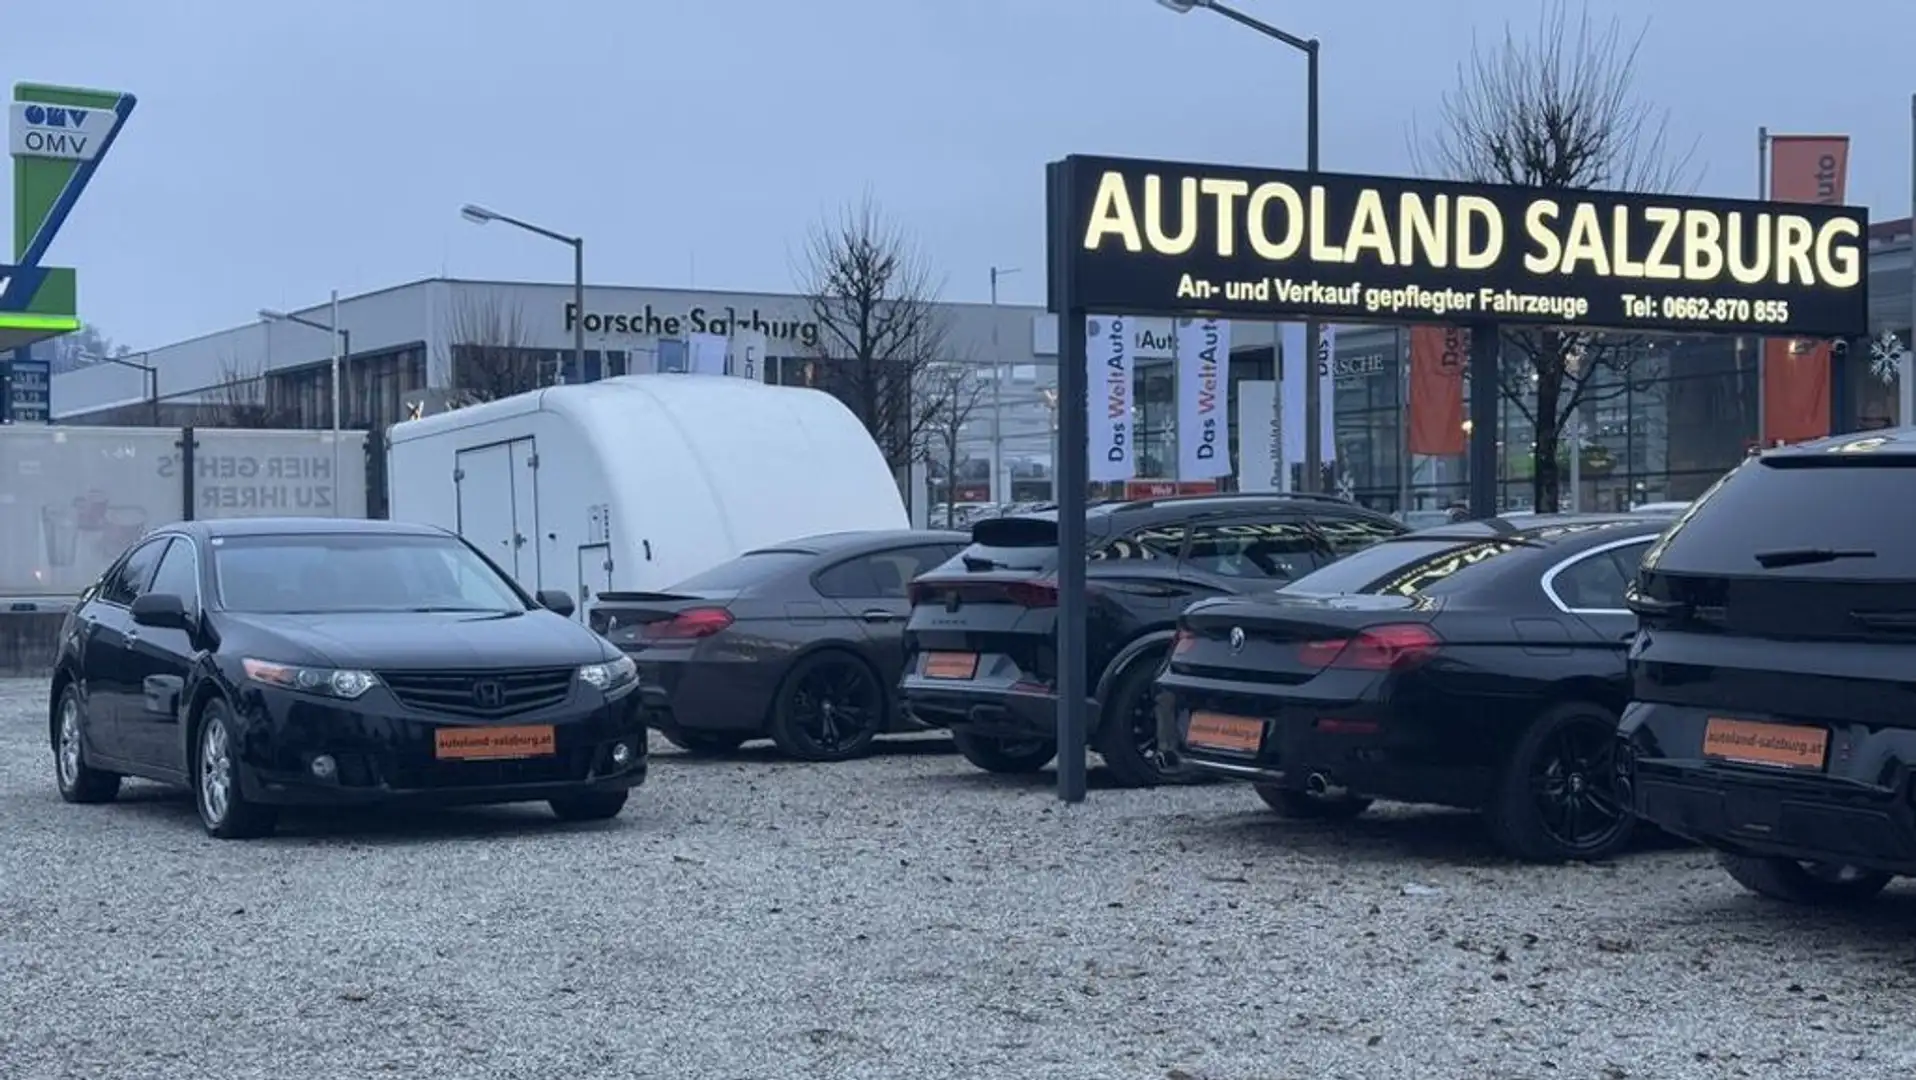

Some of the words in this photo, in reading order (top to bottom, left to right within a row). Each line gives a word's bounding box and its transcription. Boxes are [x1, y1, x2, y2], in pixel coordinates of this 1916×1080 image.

[25, 131, 87, 154] OMV
[1813, 153, 1836, 204] uto
[1083, 170, 1503, 270] AUTOLAND
[1524, 199, 1860, 288] SALZBURG
[1177, 273, 1219, 300] An-
[1225, 277, 1269, 302] und
[1274, 279, 1361, 306] Verkauf
[1365, 283, 1475, 313] gepflegter
[1480, 288, 1588, 320] Fahrzeuge
[1621, 294, 1658, 319] Tel:
[1663, 296, 1749, 322] 0662-870
[1753, 301, 1789, 323] 855
[565, 303, 679, 335] Porsche
[1108, 423, 1126, 462] Das
[1197, 418, 1216, 460] Das
[438, 733, 552, 750] autoland-salzburg.at
